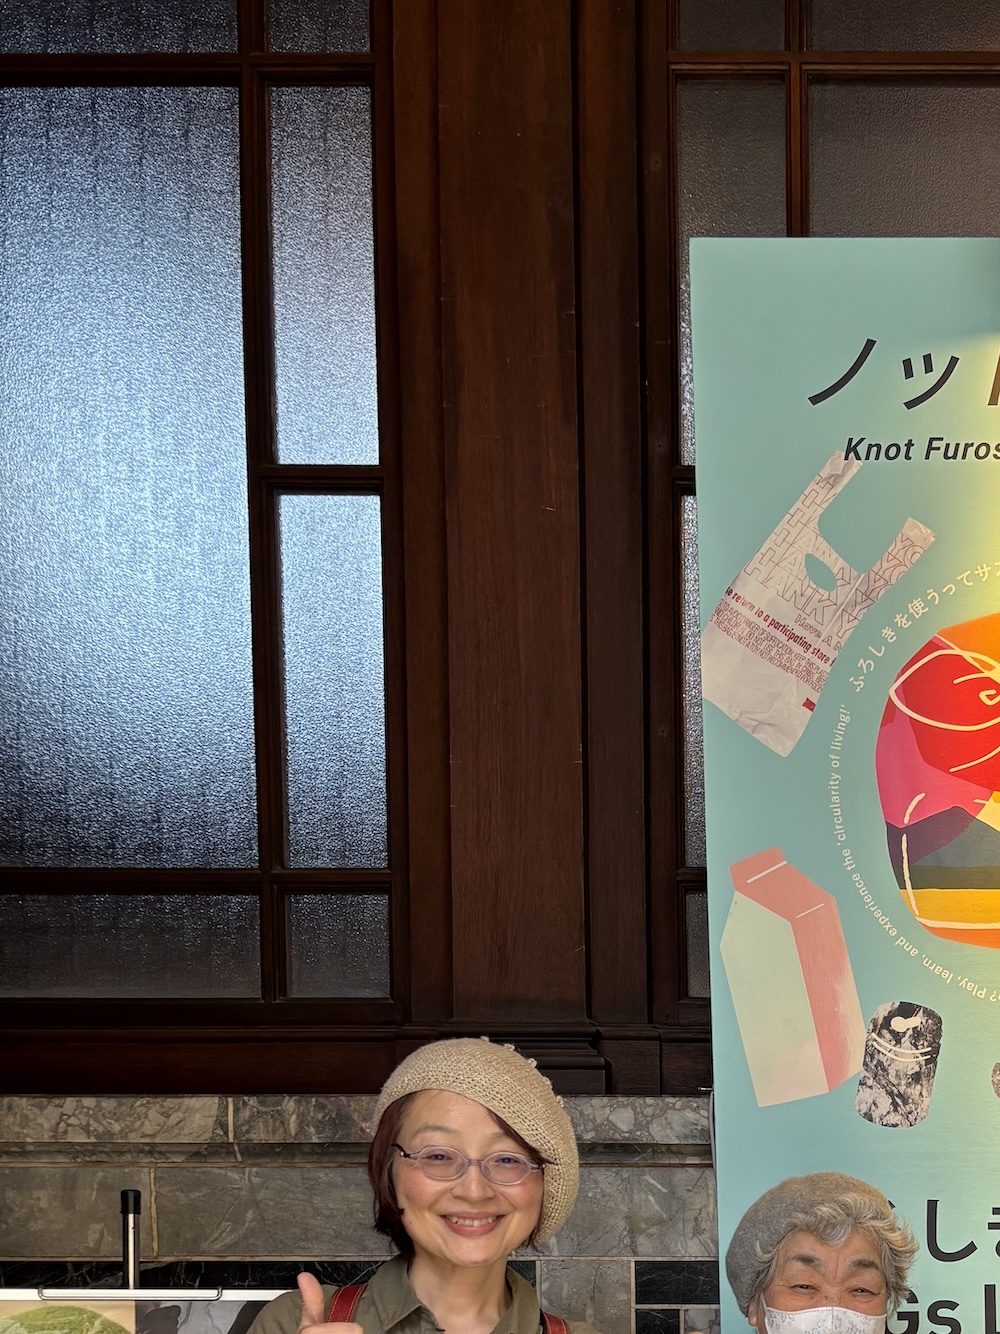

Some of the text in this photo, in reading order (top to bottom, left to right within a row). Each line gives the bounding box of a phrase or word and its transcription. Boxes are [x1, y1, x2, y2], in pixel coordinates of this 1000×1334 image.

[844, 437, 914, 462] Knot
[733, 592, 755, 611] return
[768, 617, 813, 653] participating
[811, 647, 831, 664] store
[828, 754, 841, 768] of
[842, 849, 856, 871] the
[852, 873, 898, 937] experience
[895, 936, 919, 957] and
[921, 953, 954, 984] learn,
[957, 975, 986, 999] Play,
